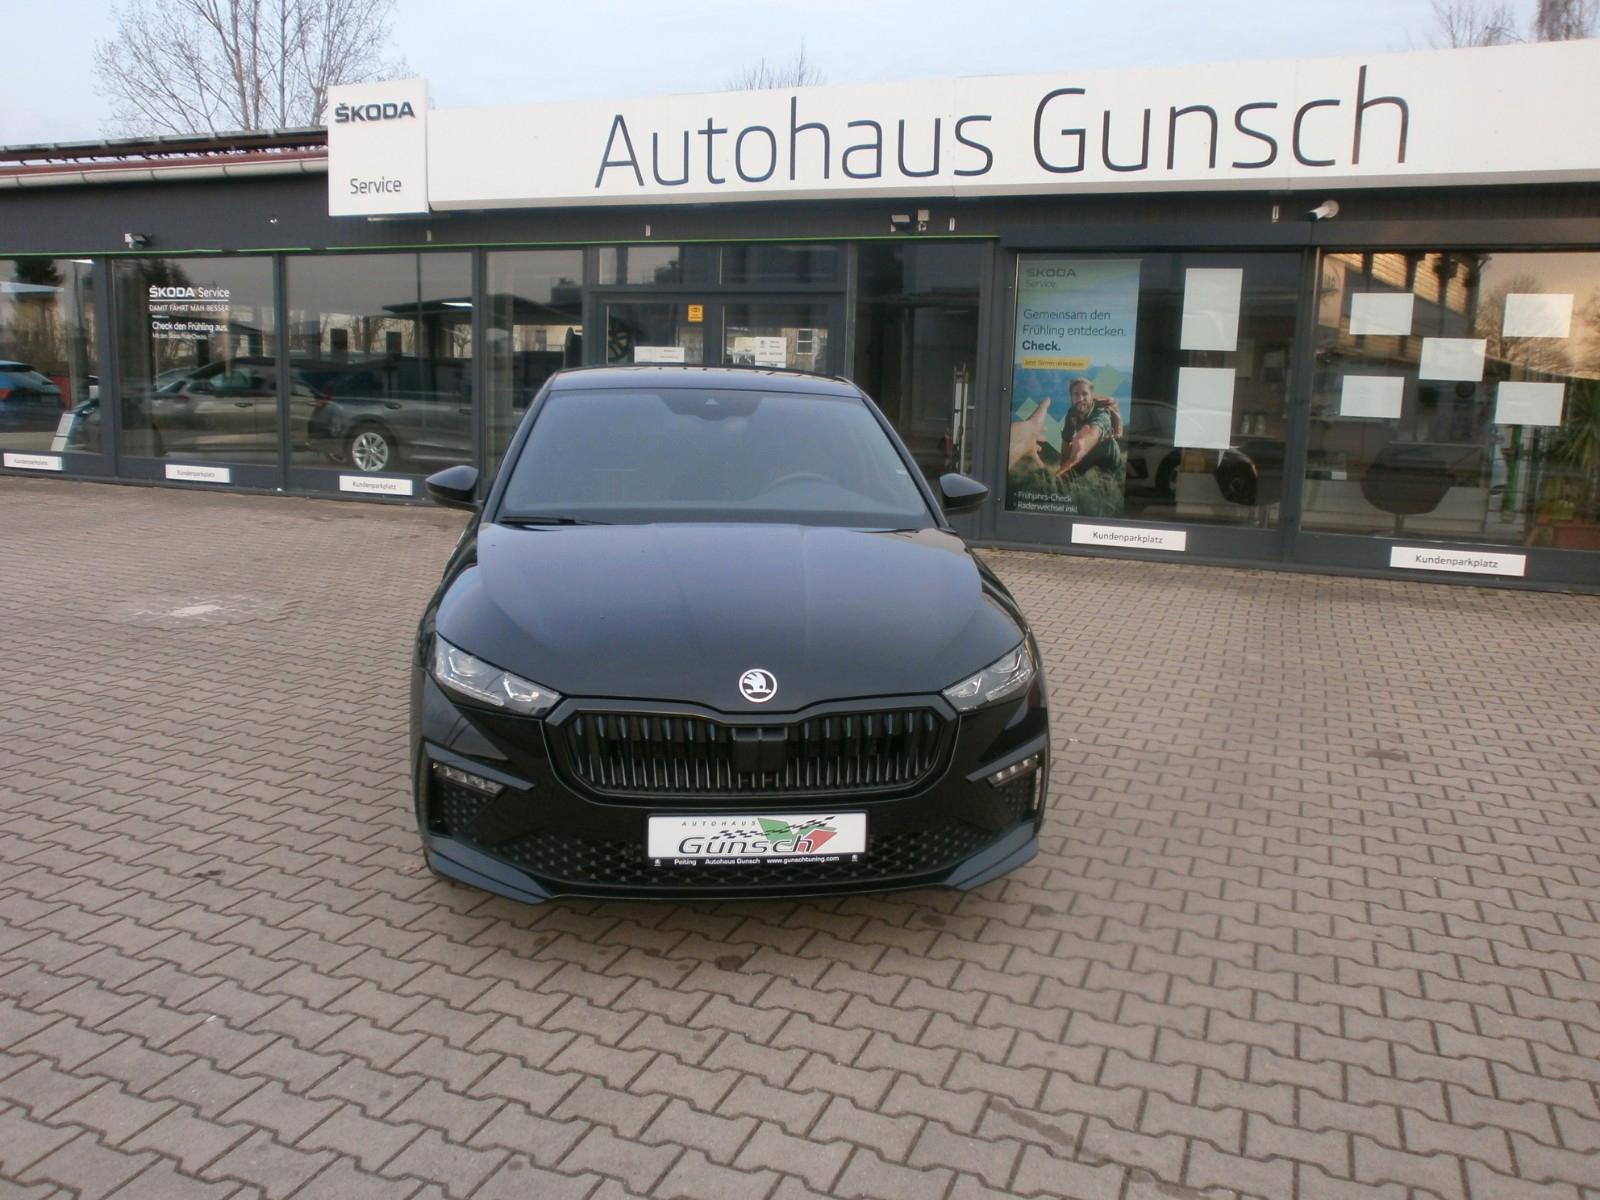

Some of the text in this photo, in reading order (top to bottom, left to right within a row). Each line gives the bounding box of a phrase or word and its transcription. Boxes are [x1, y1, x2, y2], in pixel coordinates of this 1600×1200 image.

[335, 102, 416, 123] ŠKODA
[594, 65, 1409, 189] Autohaus Gunsch
[350, 176, 402, 194] Service
[149, 285, 230, 298] ŠKODA Service
[148, 304, 168, 312] DAMIT
[190, 304, 205, 312] MAN
[1022, 308, 1111, 320] Gemeinsam den
[151, 320, 173, 331] Check
[173, 321, 187, 331] den
[1067, 326, 1127, 337] entdecken.
[1022, 340, 1062, 351] Check.
[1092, 531, 1164, 544] Kundenparkplatz
[1415, 554, 1499, 568] Kundenparkplatz
[678, 834, 813, 855] Gunsch
[736, 857, 761, 865] Gunsch
[766, 855, 840, 865] www.gunschtuning.com
